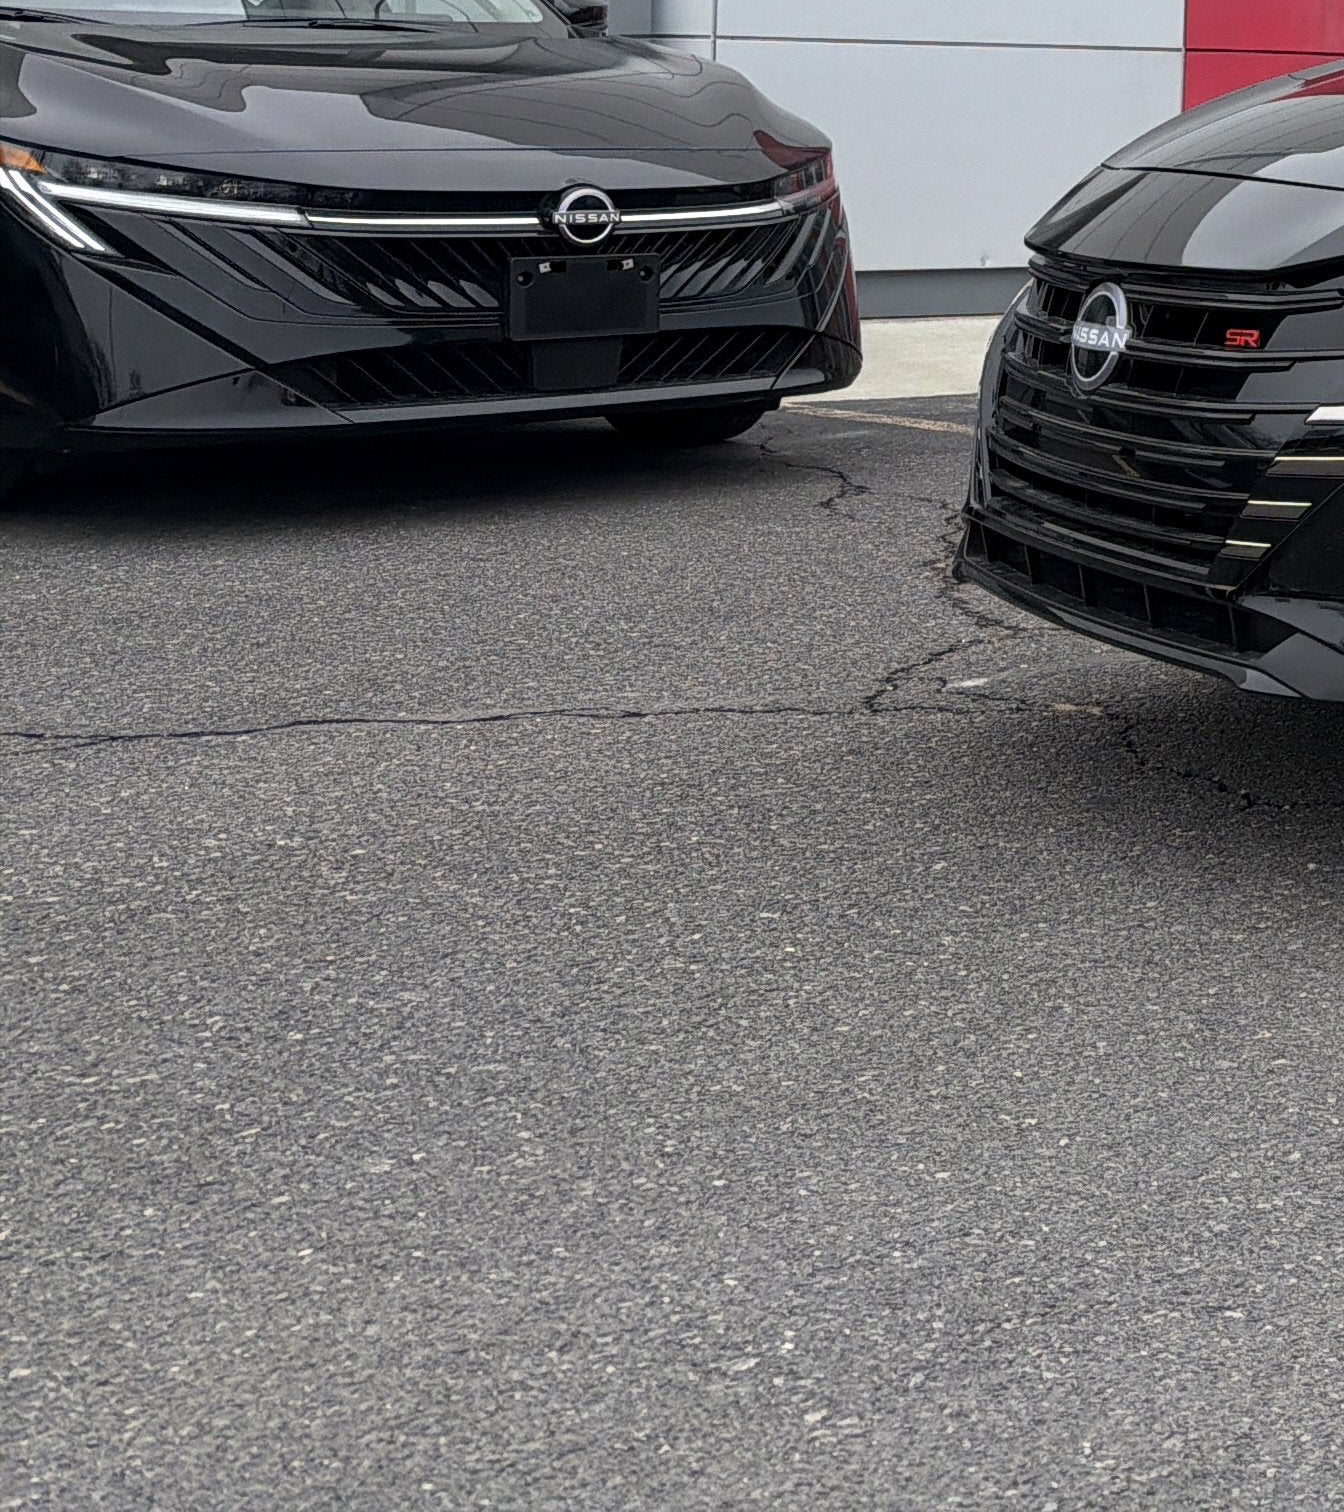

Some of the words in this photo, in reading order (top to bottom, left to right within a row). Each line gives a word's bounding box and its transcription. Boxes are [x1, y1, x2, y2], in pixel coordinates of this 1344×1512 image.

[554, 213, 620, 224] NISSAN
[1072, 324, 1129, 349] NISSAN
[1223, 328, 1260, 348] SR
